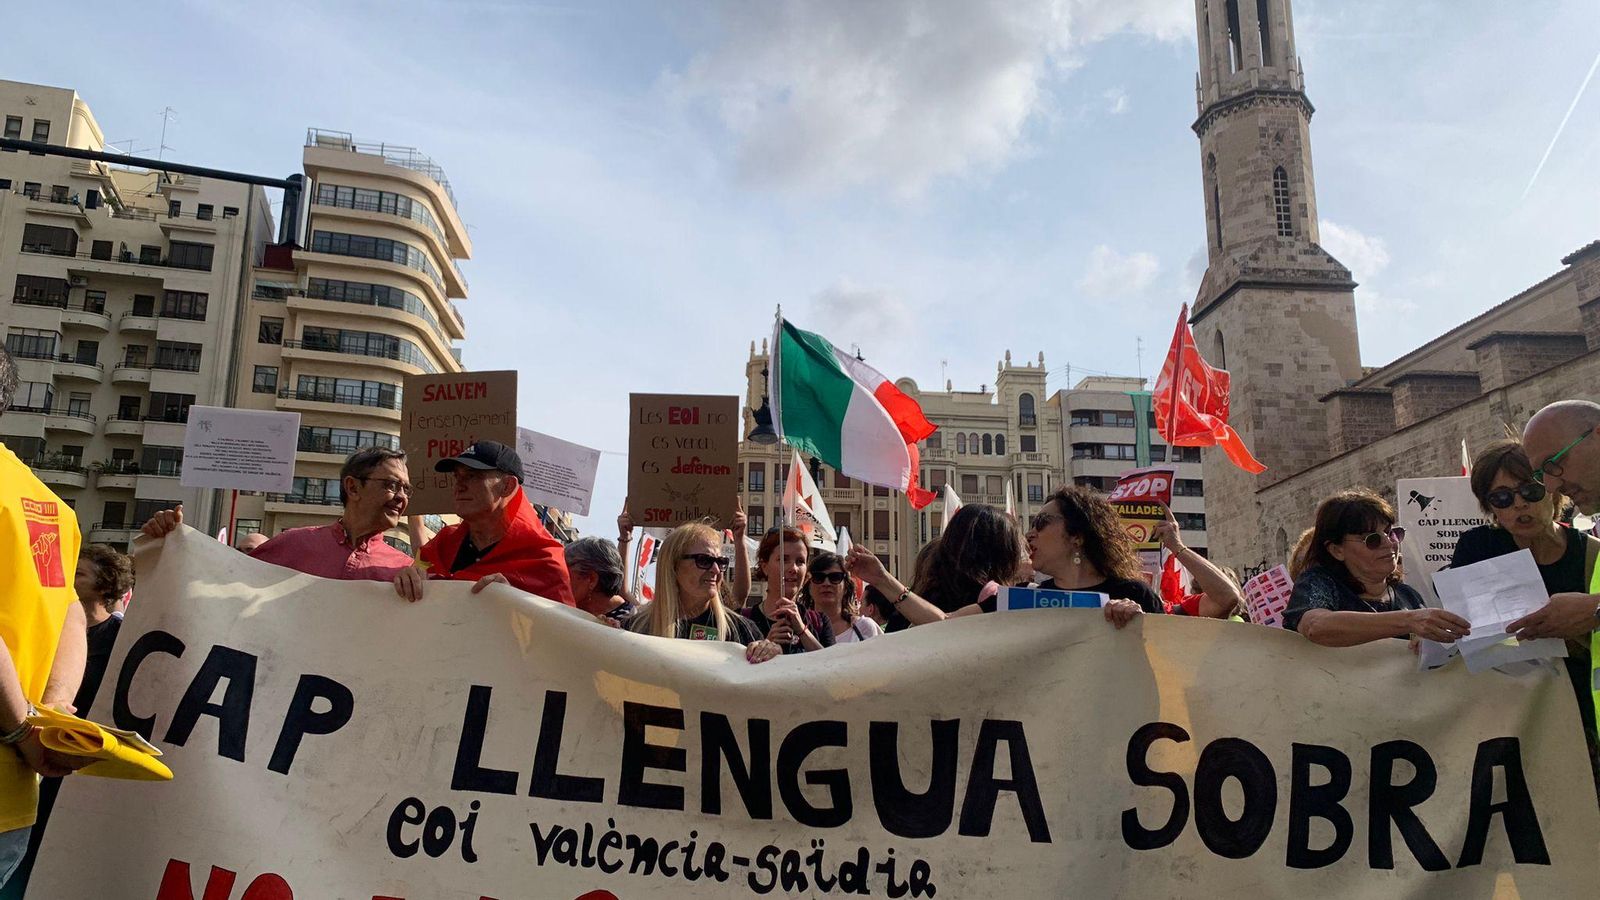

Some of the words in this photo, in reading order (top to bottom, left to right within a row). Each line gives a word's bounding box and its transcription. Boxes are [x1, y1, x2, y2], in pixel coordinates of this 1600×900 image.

[422, 382, 487, 402] SALVEM
[409, 410, 510, 432] l'ensenyament
[639, 407, 663, 425] Les
[668, 406, 699, 424] EOI
[706, 412, 731, 425] no
[651, 436, 669, 450] es
[641, 460, 660, 474] es
[670, 456, 731, 475] defenen
[1111, 477, 1168, 499] STOP
[643, 508, 672, 522] STOP
[1418, 518, 1440, 527] CAP
[1425, 554, 1454, 562] CONS
[1039, 597, 1066, 608] eoi
[112, 630, 355, 776] CAP
[451, 685, 1052, 844] LLENGUA
[1121, 722, 1551, 872] SOBRA
[386, 796, 481, 864] eoi
[529, 817, 937, 899] valència-saïdia
